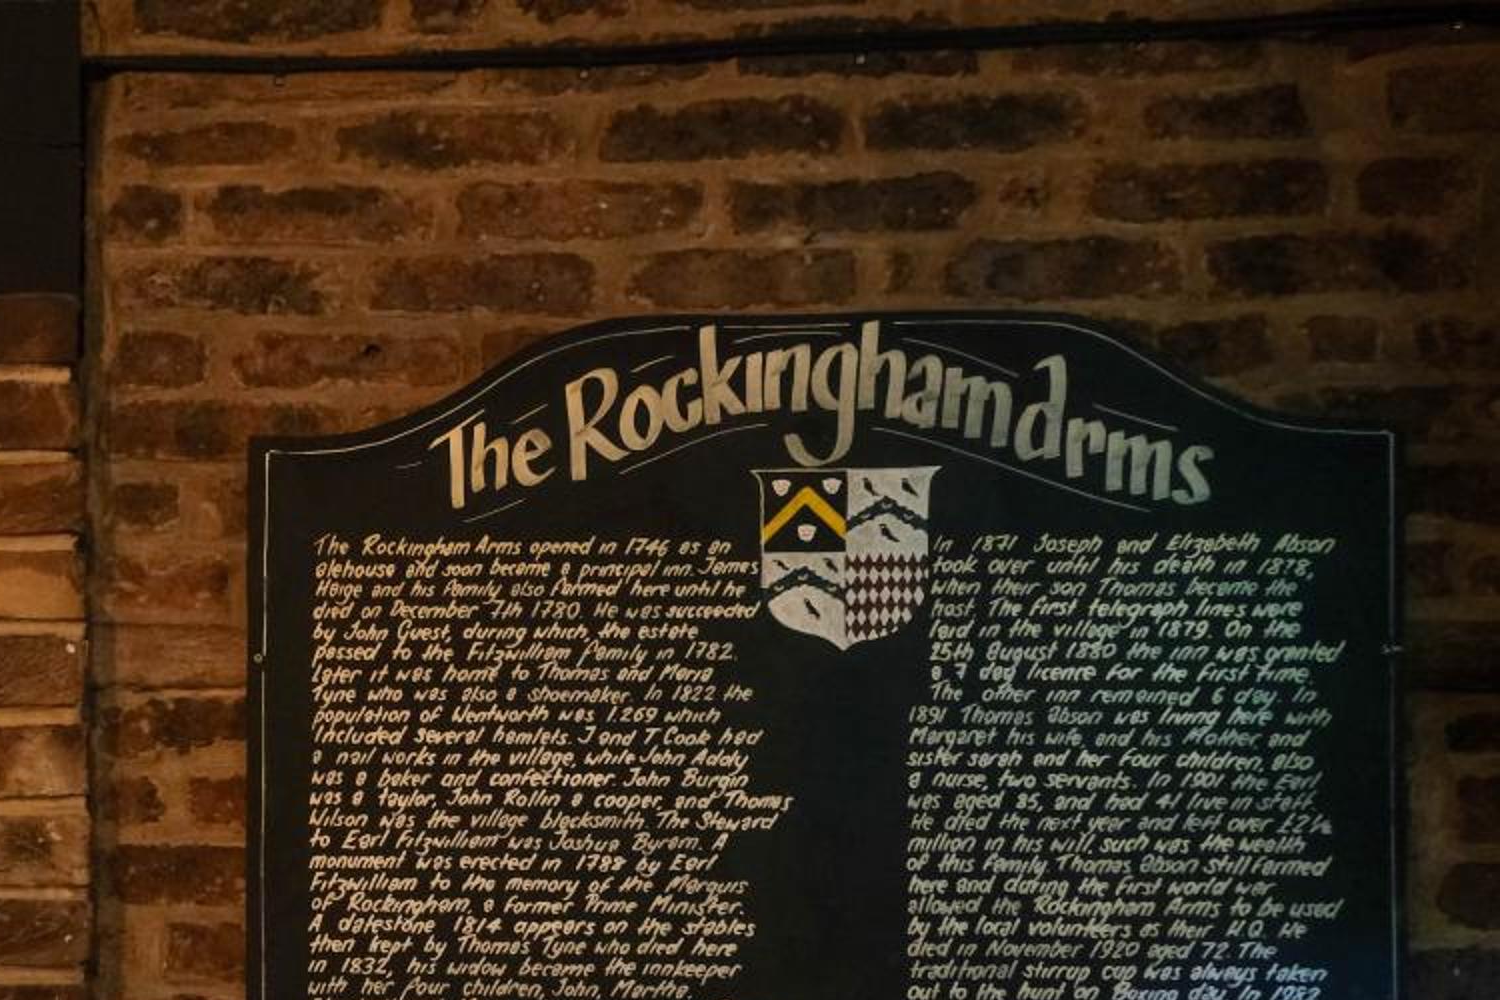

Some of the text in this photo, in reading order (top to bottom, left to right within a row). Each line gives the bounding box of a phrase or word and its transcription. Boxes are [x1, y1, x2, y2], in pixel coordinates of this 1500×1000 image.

[428, 405, 556, 510] The
[564, 320, 1012, 481] Rockingham
[314, 534, 349, 555] The
[362, 534, 470, 563] Rockingham
[475, 534, 522, 555] Arms
[530, 536, 595, 560] opened
[625, 538, 669, 556] 1746
[679, 540, 701, 555] as
[709, 539, 732, 554] an
[932, 535, 954, 552] In
[1033, 534, 1103, 561] Joseph
[1117, 532, 1158, 554] and
[1166, 532, 1261, 559] Elizabeth
[930, 619, 975, 640] laid
[978, 623, 1001, 638] in
[1009, 618, 1043, 638] the
[1053, 620, 1121, 643] village
[1129, 625, 1150, 639] in
[1224, 620, 1253, 639] On
[1263, 620, 1301, 639] the
[312, 642, 382, 668] passed
[393, 643, 412, 660] to
[422, 643, 454, 662] the
[576, 641, 648, 668] family
[655, 647, 674, 660] in
[311, 706, 411, 730] population
[419, 705, 443, 723] of
[452, 704, 551, 723] Wentworth
[558, 709, 596, 721] was
[664, 707, 721, 723] which
[314, 725, 408, 745] Included
[599, 729, 637, 746] and
[662, 726, 711, 745] Cook
[718, 727, 764, 746] had
[309, 808, 368, 827] Wilson
[379, 813, 416, 828] was
[427, 810, 461, 829] the
[470, 809, 528, 838] village
[655, 810, 690, 829] The
[696, 812, 779, 831] Steward
[309, 933, 738, 962] then kept by Thomas Tyne who died here
[908, 937, 953, 957] died
[957, 944, 978, 956] in
[985, 938, 1085, 958] November
[1090, 939, 1140, 959] 1920
[1147, 941, 1196, 965] aged
[1238, 941, 1277, 955] The
[1102, 965, 1137, 982] cup
[1144, 966, 1183, 981] was
[1190, 961, 1259, 989] always
[1266, 963, 1329, 982] taken
